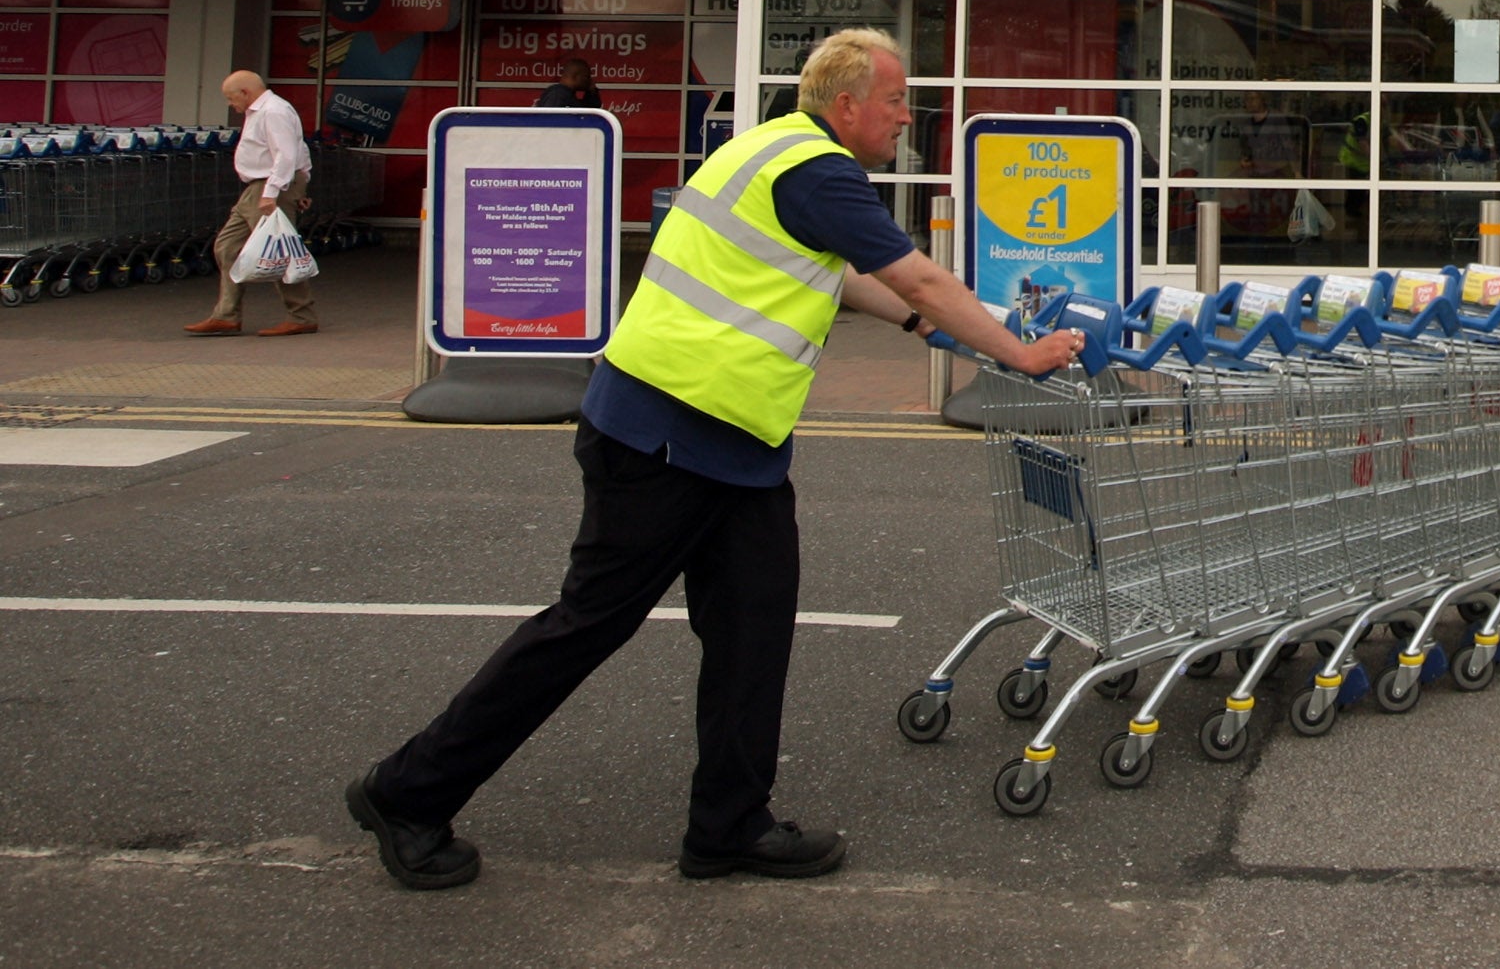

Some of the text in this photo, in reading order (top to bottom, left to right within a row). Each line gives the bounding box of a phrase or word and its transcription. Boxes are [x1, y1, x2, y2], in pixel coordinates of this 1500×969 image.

[498, 25, 648, 56] big savings
[497, 61, 645, 82] Join Clubd today
[335, 93, 391, 122] CLUBCARD
[608, 102, 642, 116] helps
[1027, 142, 1068, 162] 100s
[1003, 163, 1091, 180] of products
[470, 179, 582, 188] CUSTOMER INFORMATION
[496, 204, 528, 214] Saturday
[530, 203, 550, 212] 18th
[551, 203, 574, 214] April
[1026, 183, 1067, 229] £1
[502, 213, 527, 221] Malden
[528, 215, 545, 223] open
[523, 222, 548, 230] follows
[1038, 231, 1067, 241] under
[472, 248, 491, 256] 0600
[493, 248, 512, 256] MON
[547, 248, 582, 258] Saturday
[990, 244, 1104, 264] Household Essentials
[473, 258, 573, 267] 1000 1600 Sunday
[490, 322, 515, 335] Every
[515, 322, 535, 333] little
